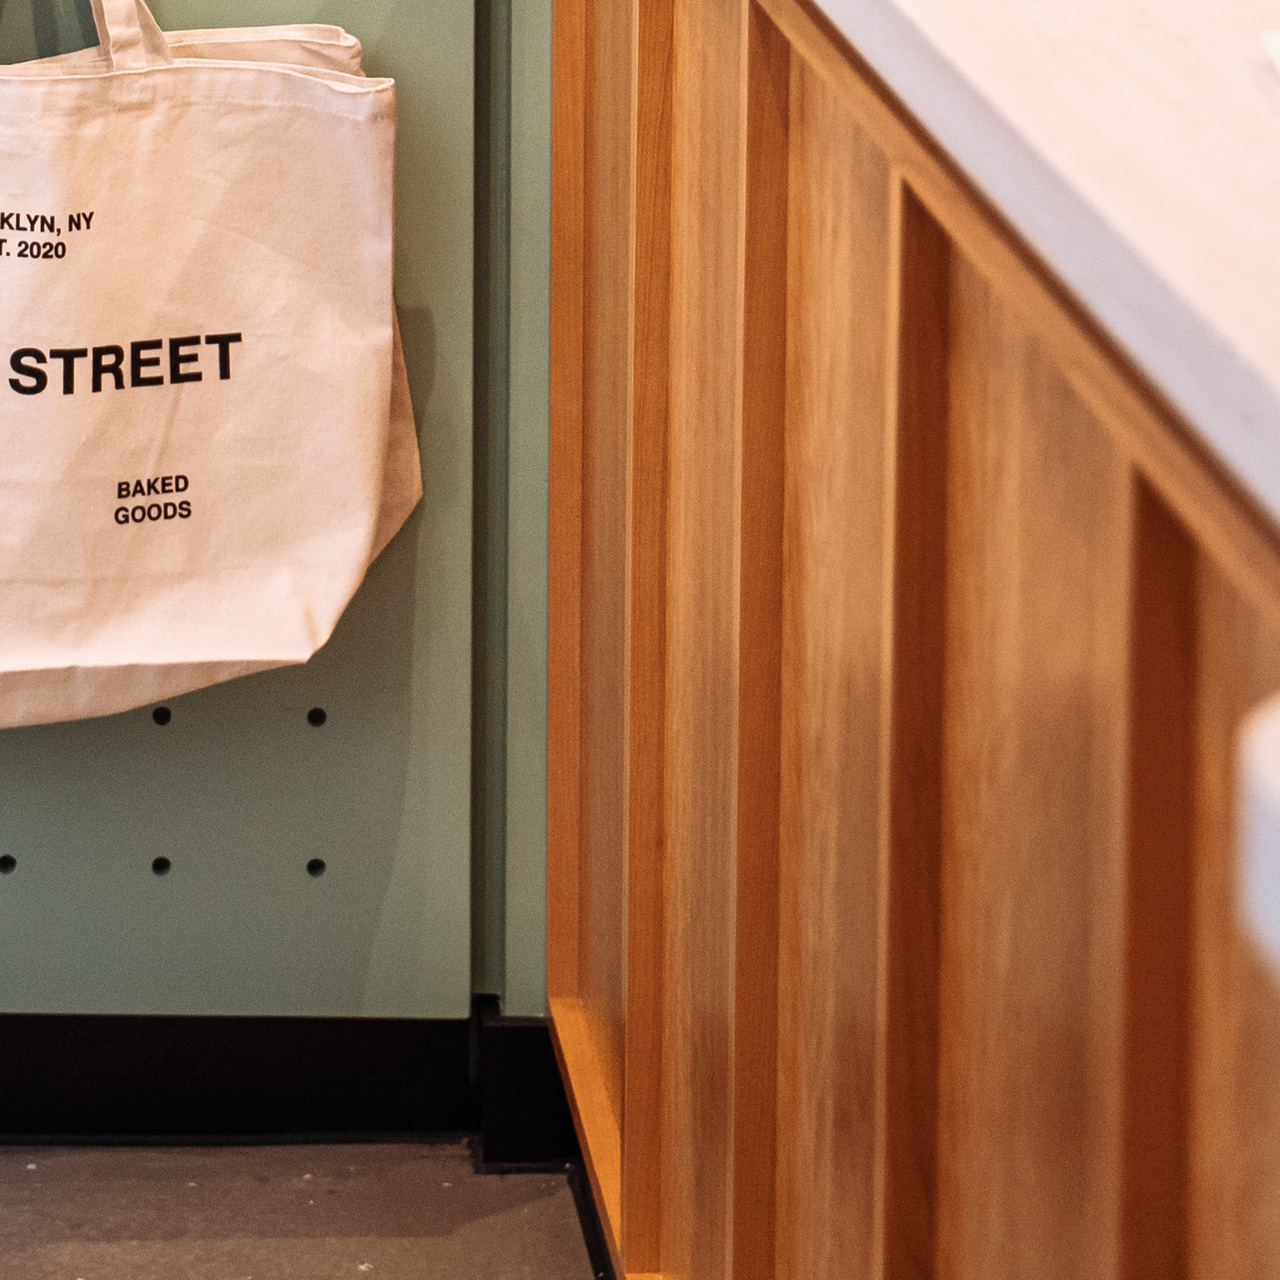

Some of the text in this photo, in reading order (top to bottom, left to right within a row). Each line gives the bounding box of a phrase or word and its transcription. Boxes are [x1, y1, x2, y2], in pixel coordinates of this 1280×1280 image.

[68, 211, 95, 232] NY
[17, 240, 67, 260] 2020
[8, 332, 243, 396] STREET
[117, 474, 189, 500] BAKED
[114, 500, 192, 525] GOODS
